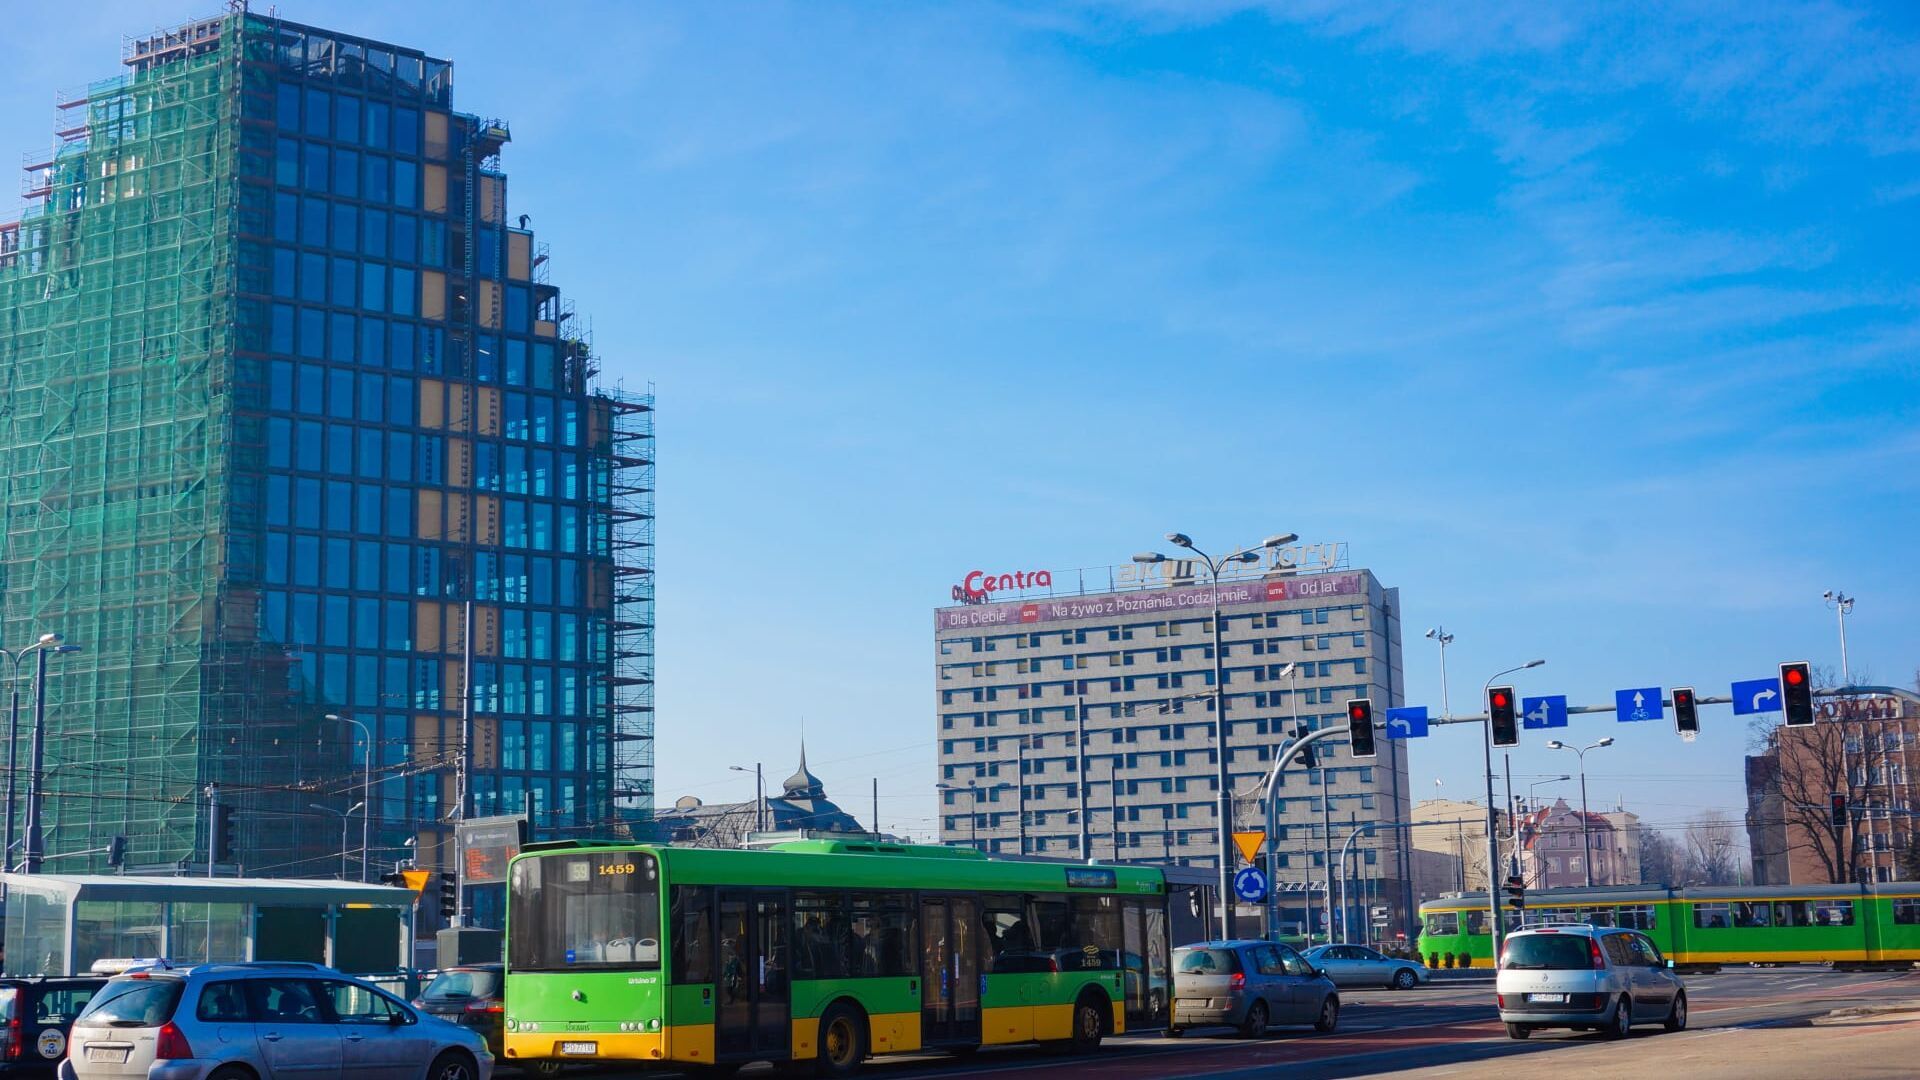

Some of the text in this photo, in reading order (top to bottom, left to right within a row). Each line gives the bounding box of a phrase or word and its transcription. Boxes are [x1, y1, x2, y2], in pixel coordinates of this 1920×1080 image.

[964, 570, 1051, 598] Centra
[1300, 580, 1337, 595] Od lat
[1052, 605, 1068, 617] Na
[1071, 602, 1103, 618] żywo
[1106, 602, 1113, 612] z
[1116, 595, 1176, 611] Poznania.
[950, 611, 1006, 625] Dla Ciebie
[1814, 697, 1898, 720] OMAT
[599, 864, 636, 875] 1459
